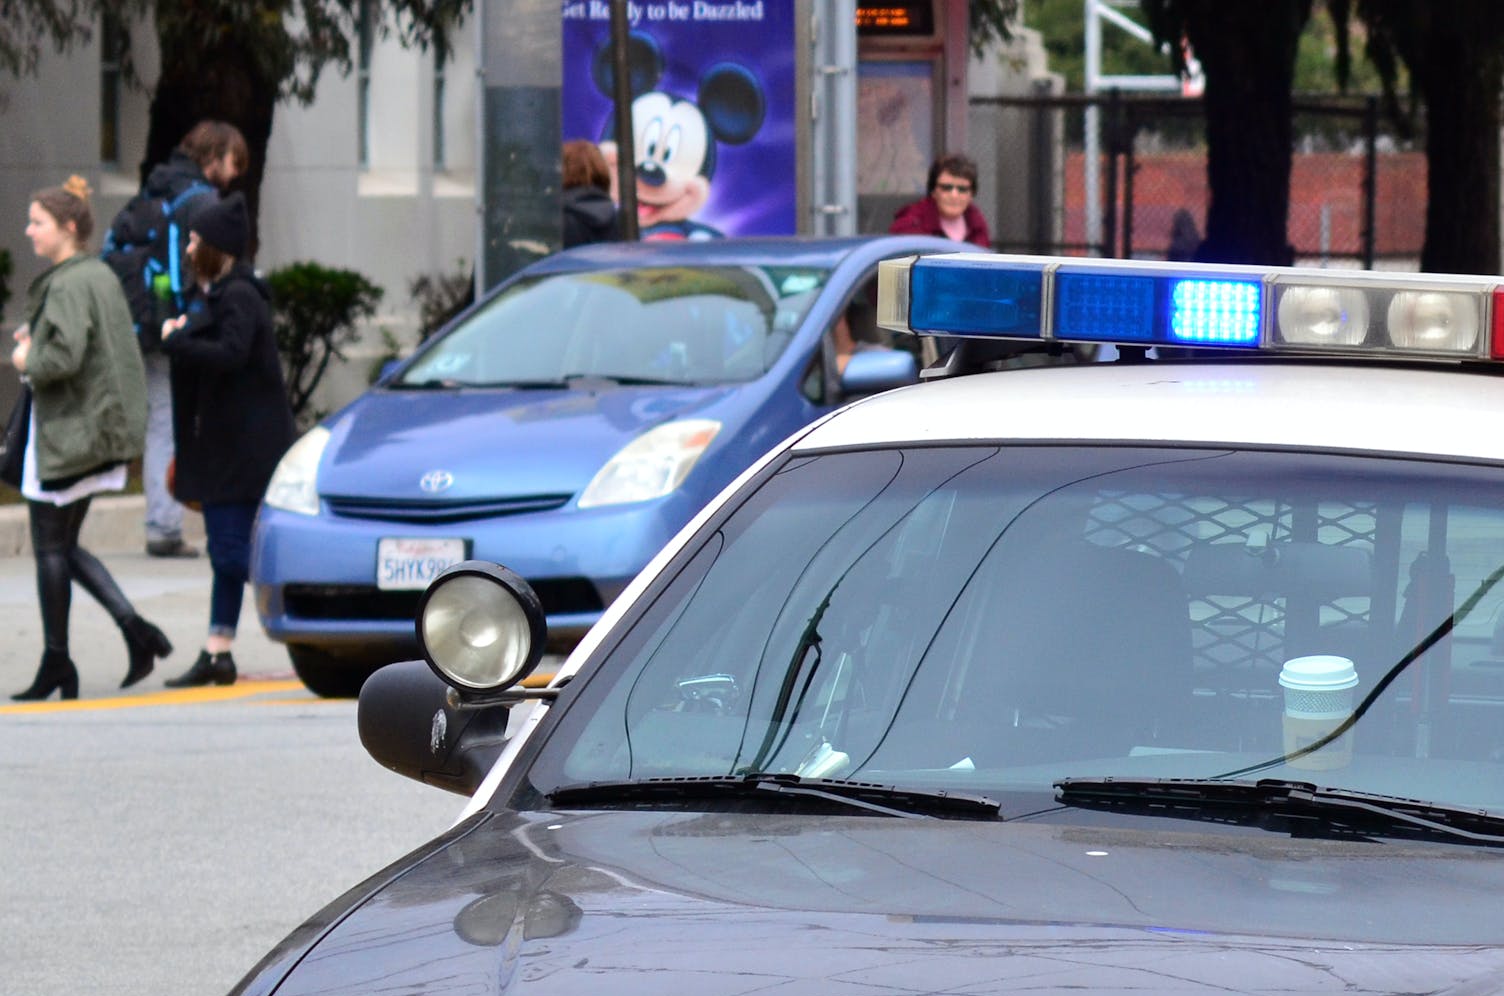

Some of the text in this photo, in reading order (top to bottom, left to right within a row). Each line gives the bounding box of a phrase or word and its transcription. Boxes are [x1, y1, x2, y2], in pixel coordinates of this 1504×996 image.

[648, 4, 665, 20] to
[668, 0, 689, 20] be
[693, 0, 764, 20] Dazzled
